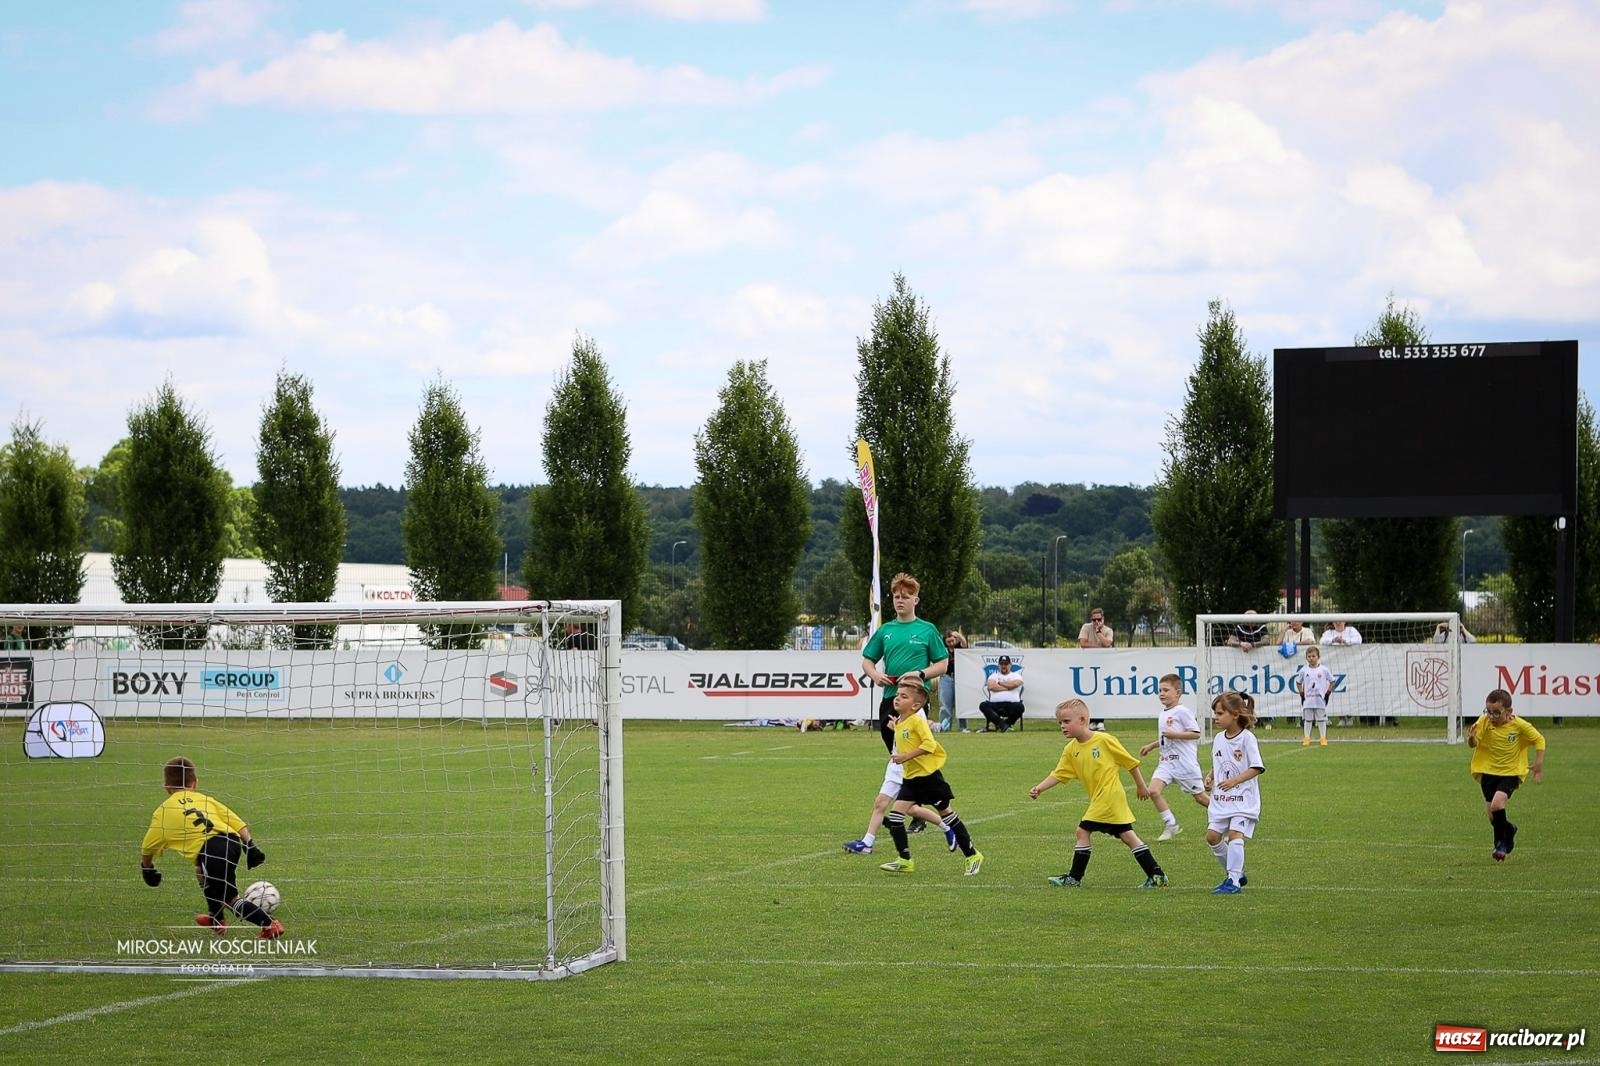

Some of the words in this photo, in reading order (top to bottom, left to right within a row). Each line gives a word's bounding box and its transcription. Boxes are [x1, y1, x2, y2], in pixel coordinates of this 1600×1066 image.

[1379, 347, 1400, 359] tel.
[1404, 347, 1429, 359] 533
[1432, 346, 1457, 358] 355
[1461, 345, 1486, 357] 677
[0, 673, 27, 684] EEF
[113, 672, 188, 695] BOXY
[1069, 666, 1160, 696] Unia
[1175, 664, 1347, 695] Racibóz
[0, 684, 27, 695] ROS
[344, 690, 380, 700] SUPRA
[383, 690, 435, 700] BROKERS
